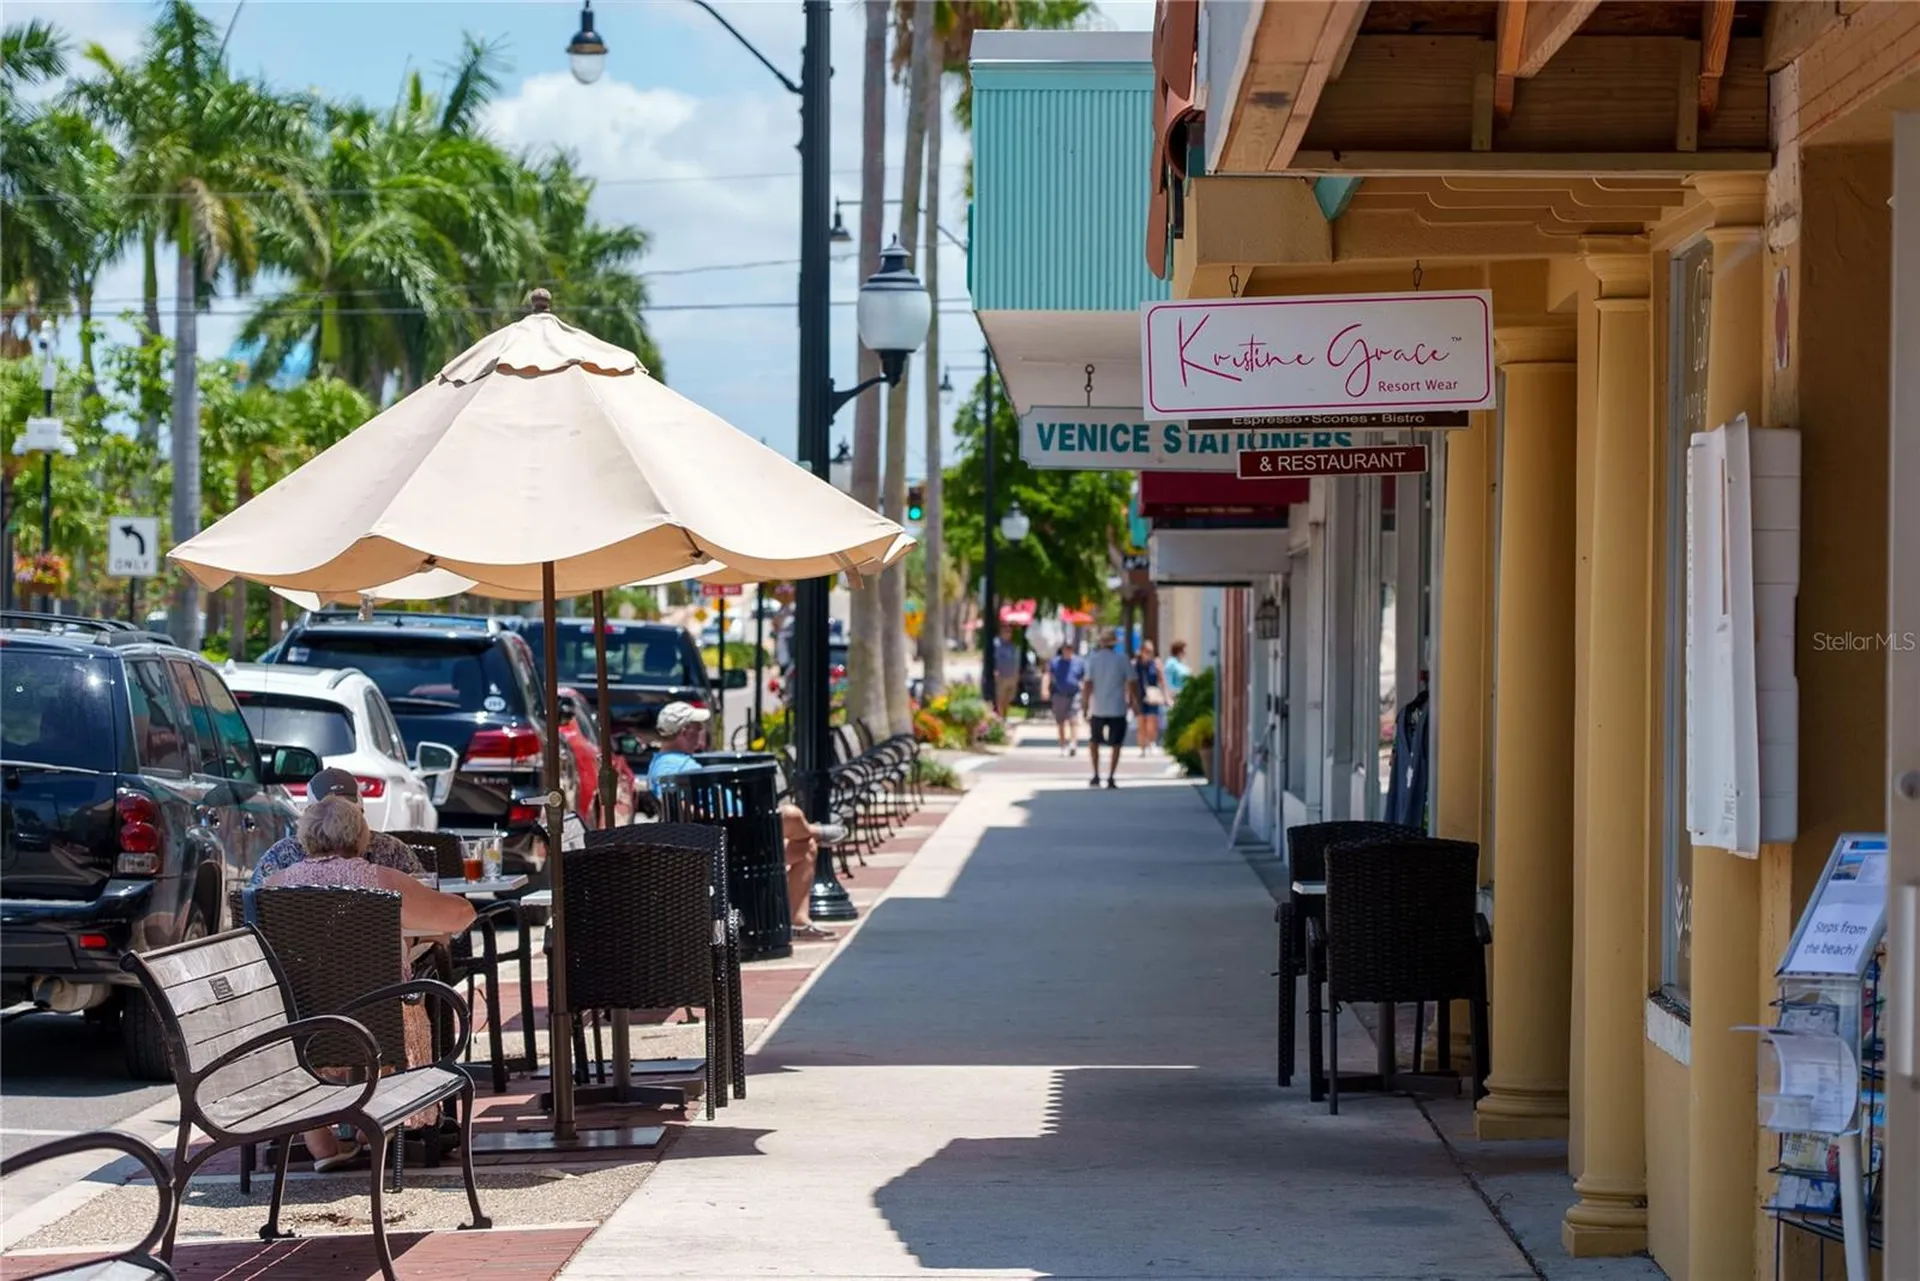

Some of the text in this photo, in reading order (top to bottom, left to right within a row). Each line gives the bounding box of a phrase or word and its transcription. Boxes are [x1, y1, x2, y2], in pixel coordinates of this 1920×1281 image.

[1178, 314, 1315, 387] Kristine
[1327, 324, 1450, 397] Grace
[1378, 379, 1458, 392] Resort Wear
[1311, 414, 1368, 424] Scones
[1381, 412, 1425, 423] Bistro
[1036, 422, 1150, 453] VENICE
[1259, 452, 1406, 472] & RESTAURANT
[114, 559, 150, 570] ONLY
[1814, 920, 1868, 935] Steps from
[1804, 942, 1859, 956] the beach!
